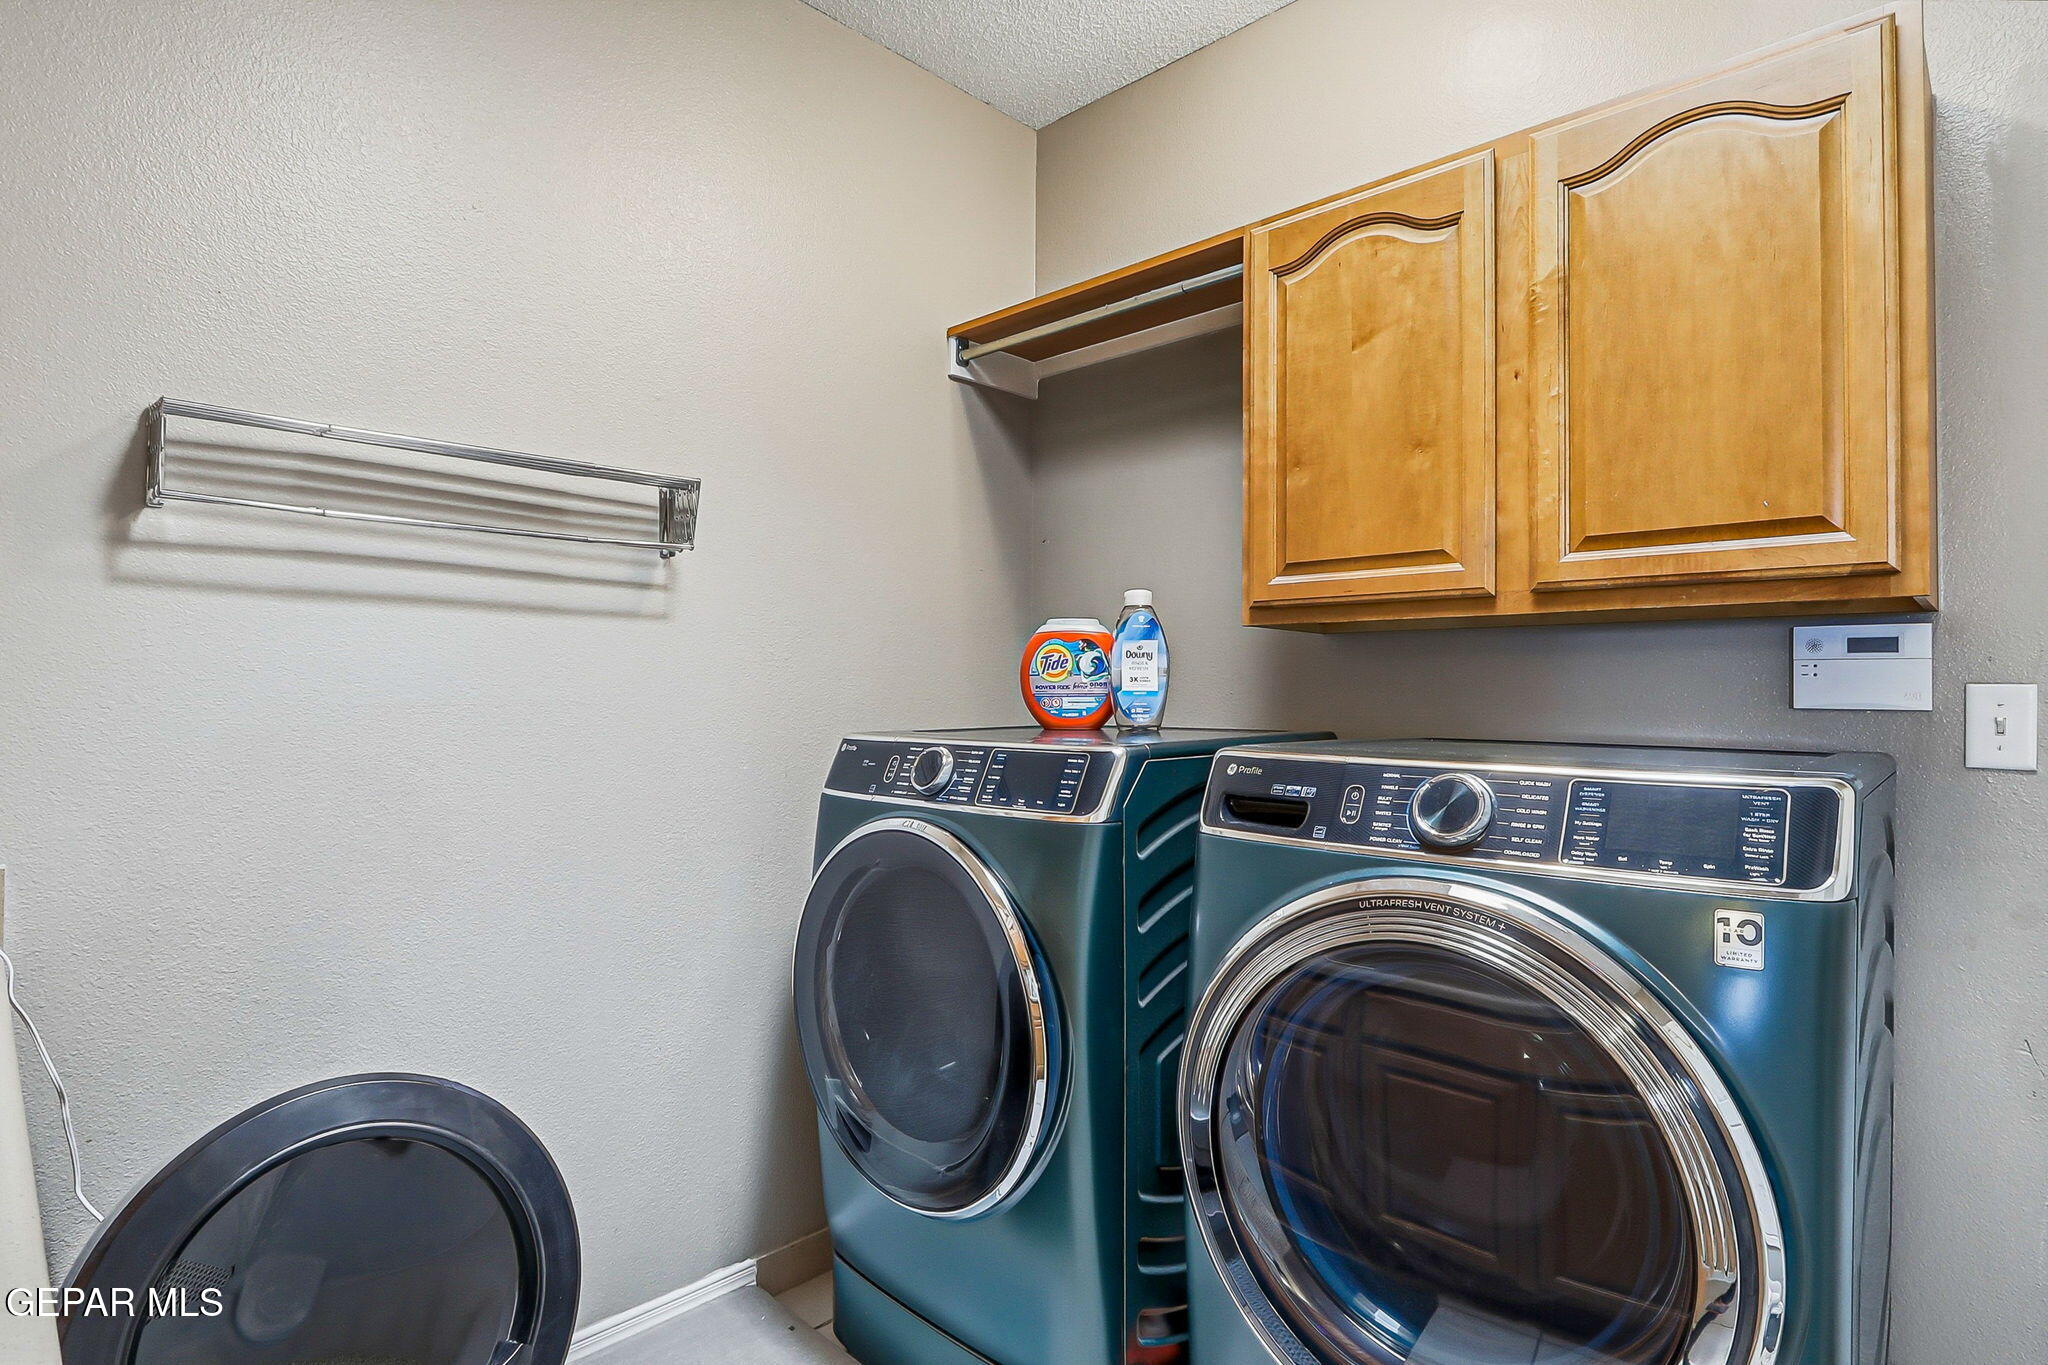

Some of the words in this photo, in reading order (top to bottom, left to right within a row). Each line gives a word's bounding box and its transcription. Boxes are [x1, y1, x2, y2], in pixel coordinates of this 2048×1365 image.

[1041, 653, 1069, 674] Tide
[1125, 650, 1153, 661] Downy
[1238, 766, 1263, 775] Profile
[1359, 900, 1422, 908] ULTRAFRESH
[1424, 902, 1452, 914] VENT
[1452, 908, 1496, 927] SYSTEM
[1717, 917, 1762, 946] 10
[1720, 955, 1758, 963] WARRANTY
